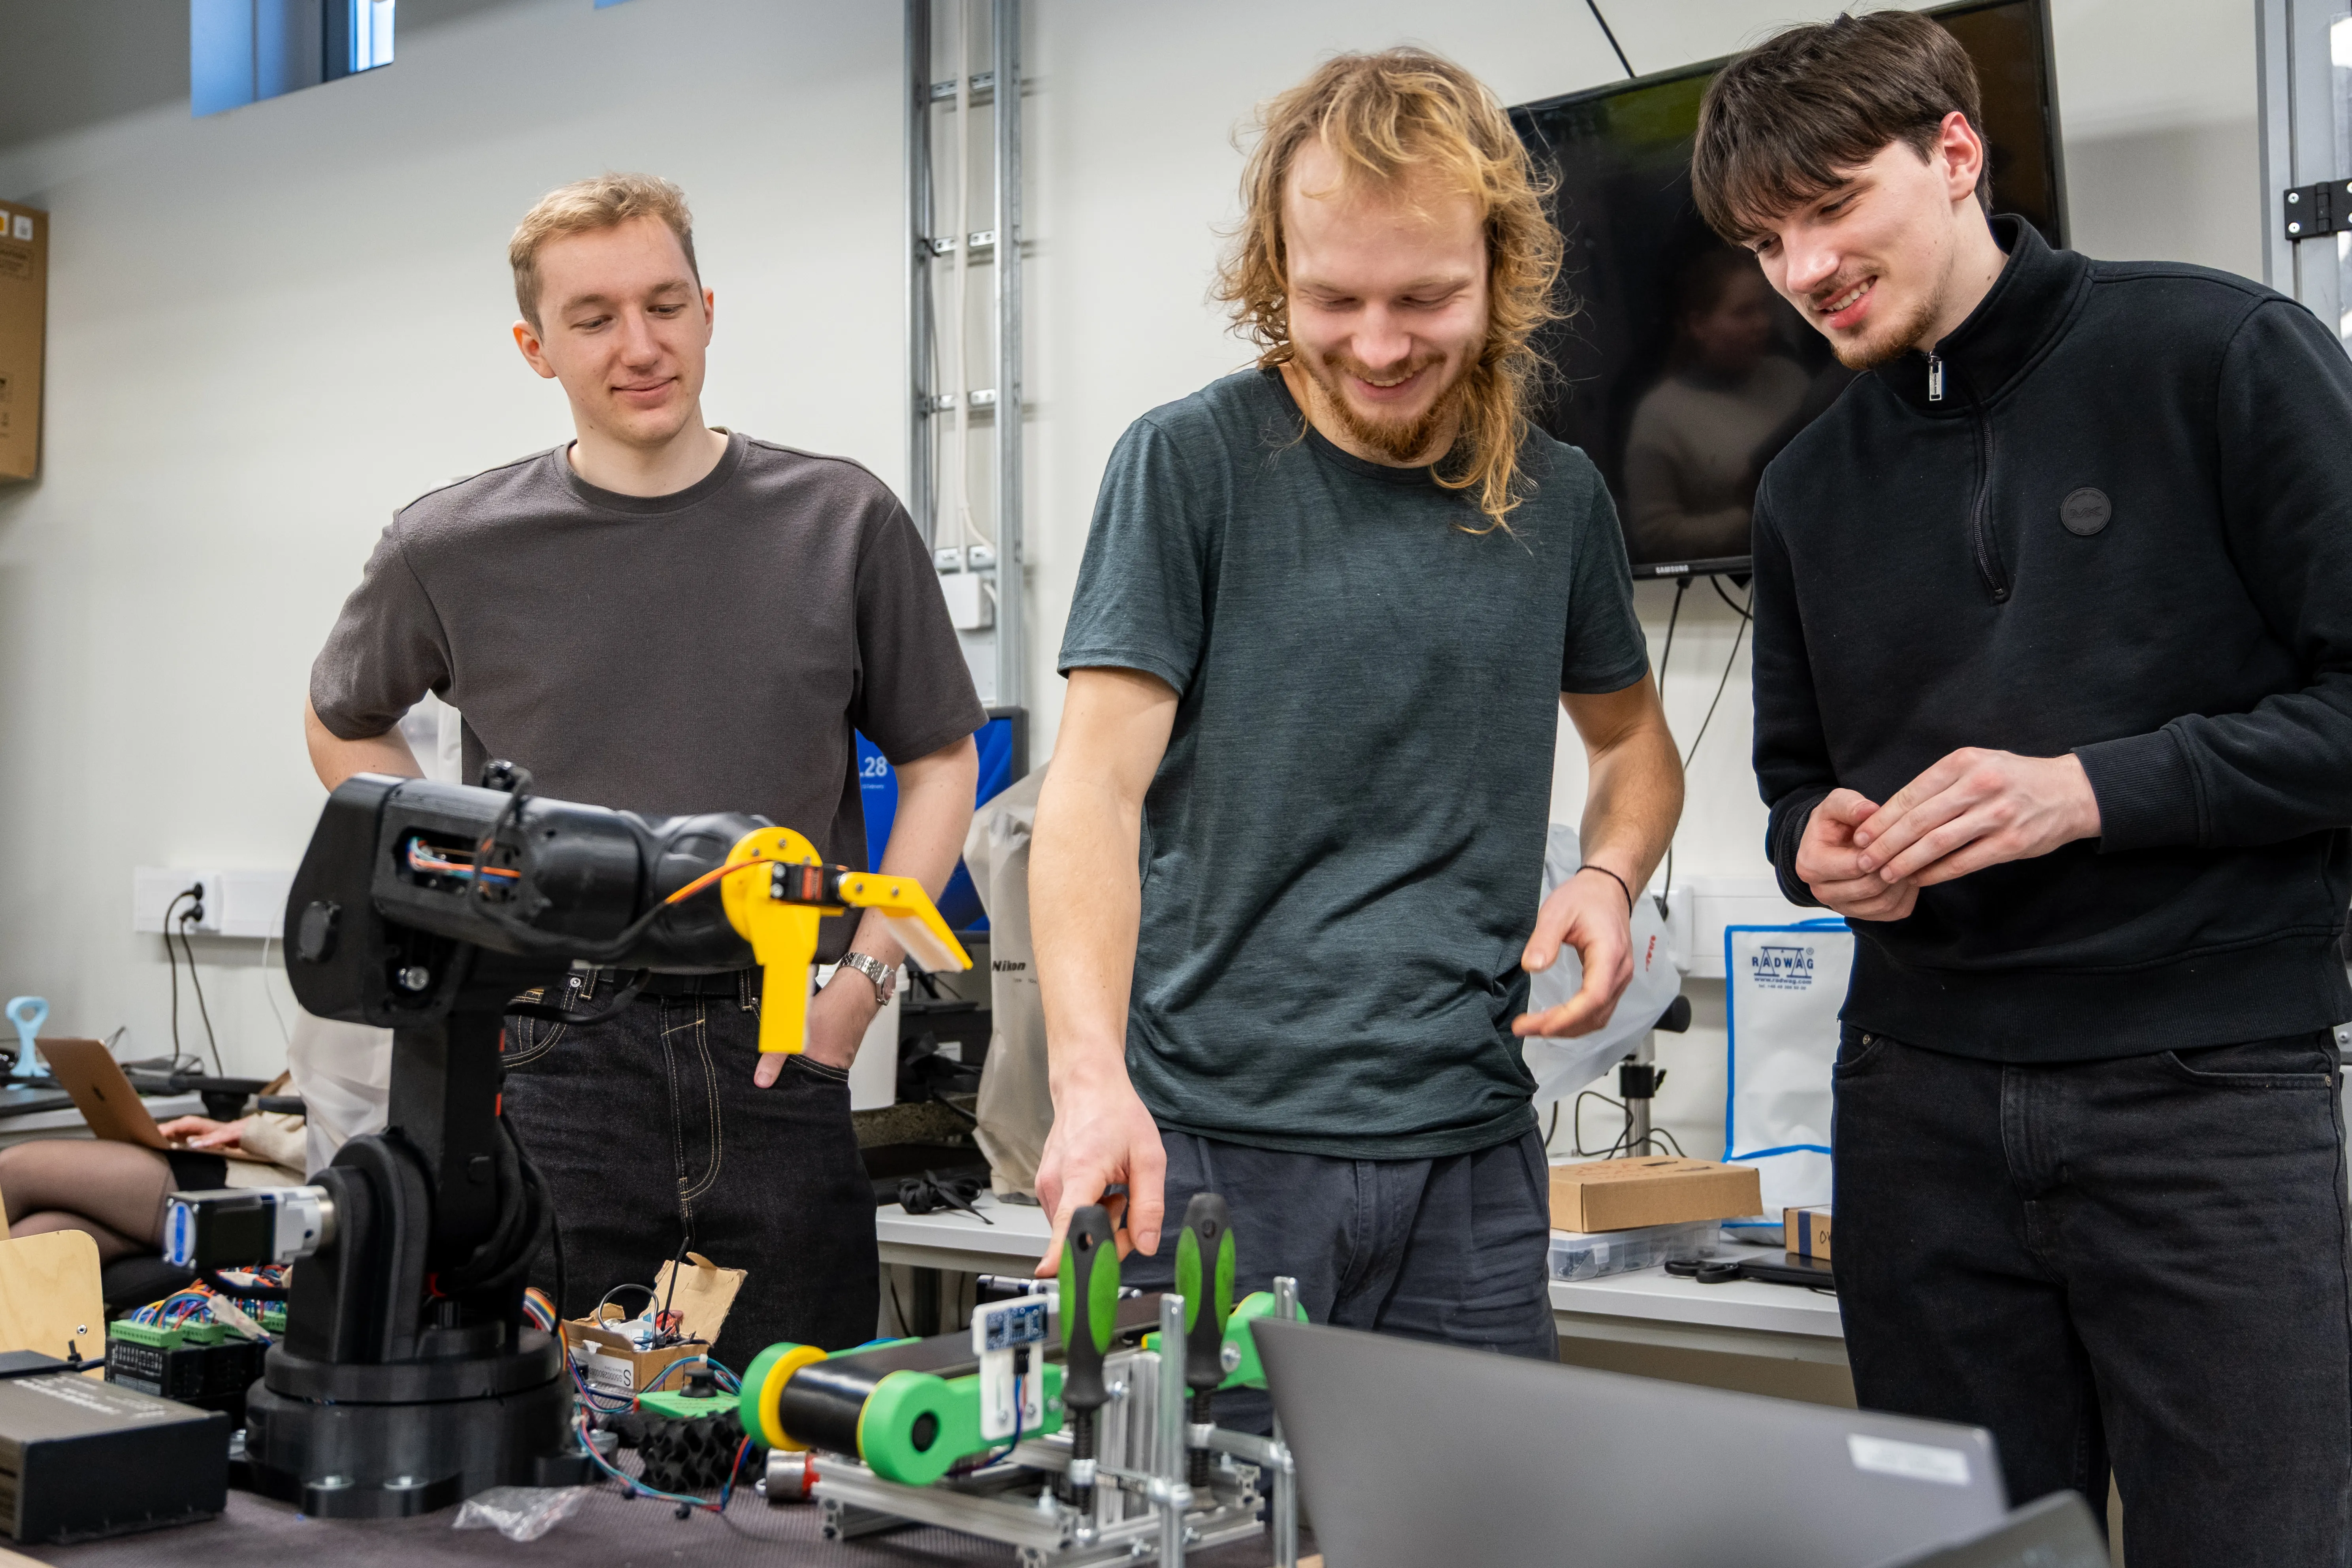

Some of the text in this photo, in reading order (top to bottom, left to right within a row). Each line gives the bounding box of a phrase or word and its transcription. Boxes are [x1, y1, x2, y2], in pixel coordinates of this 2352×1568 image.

[1656, 565, 1689, 573] SAMSUNG
[859, 756, 888, 776] .28
[992, 960, 1026, 972] Nikon
[1752, 956, 1813, 969] RADWAG
[624, 1370, 631, 1387] S
